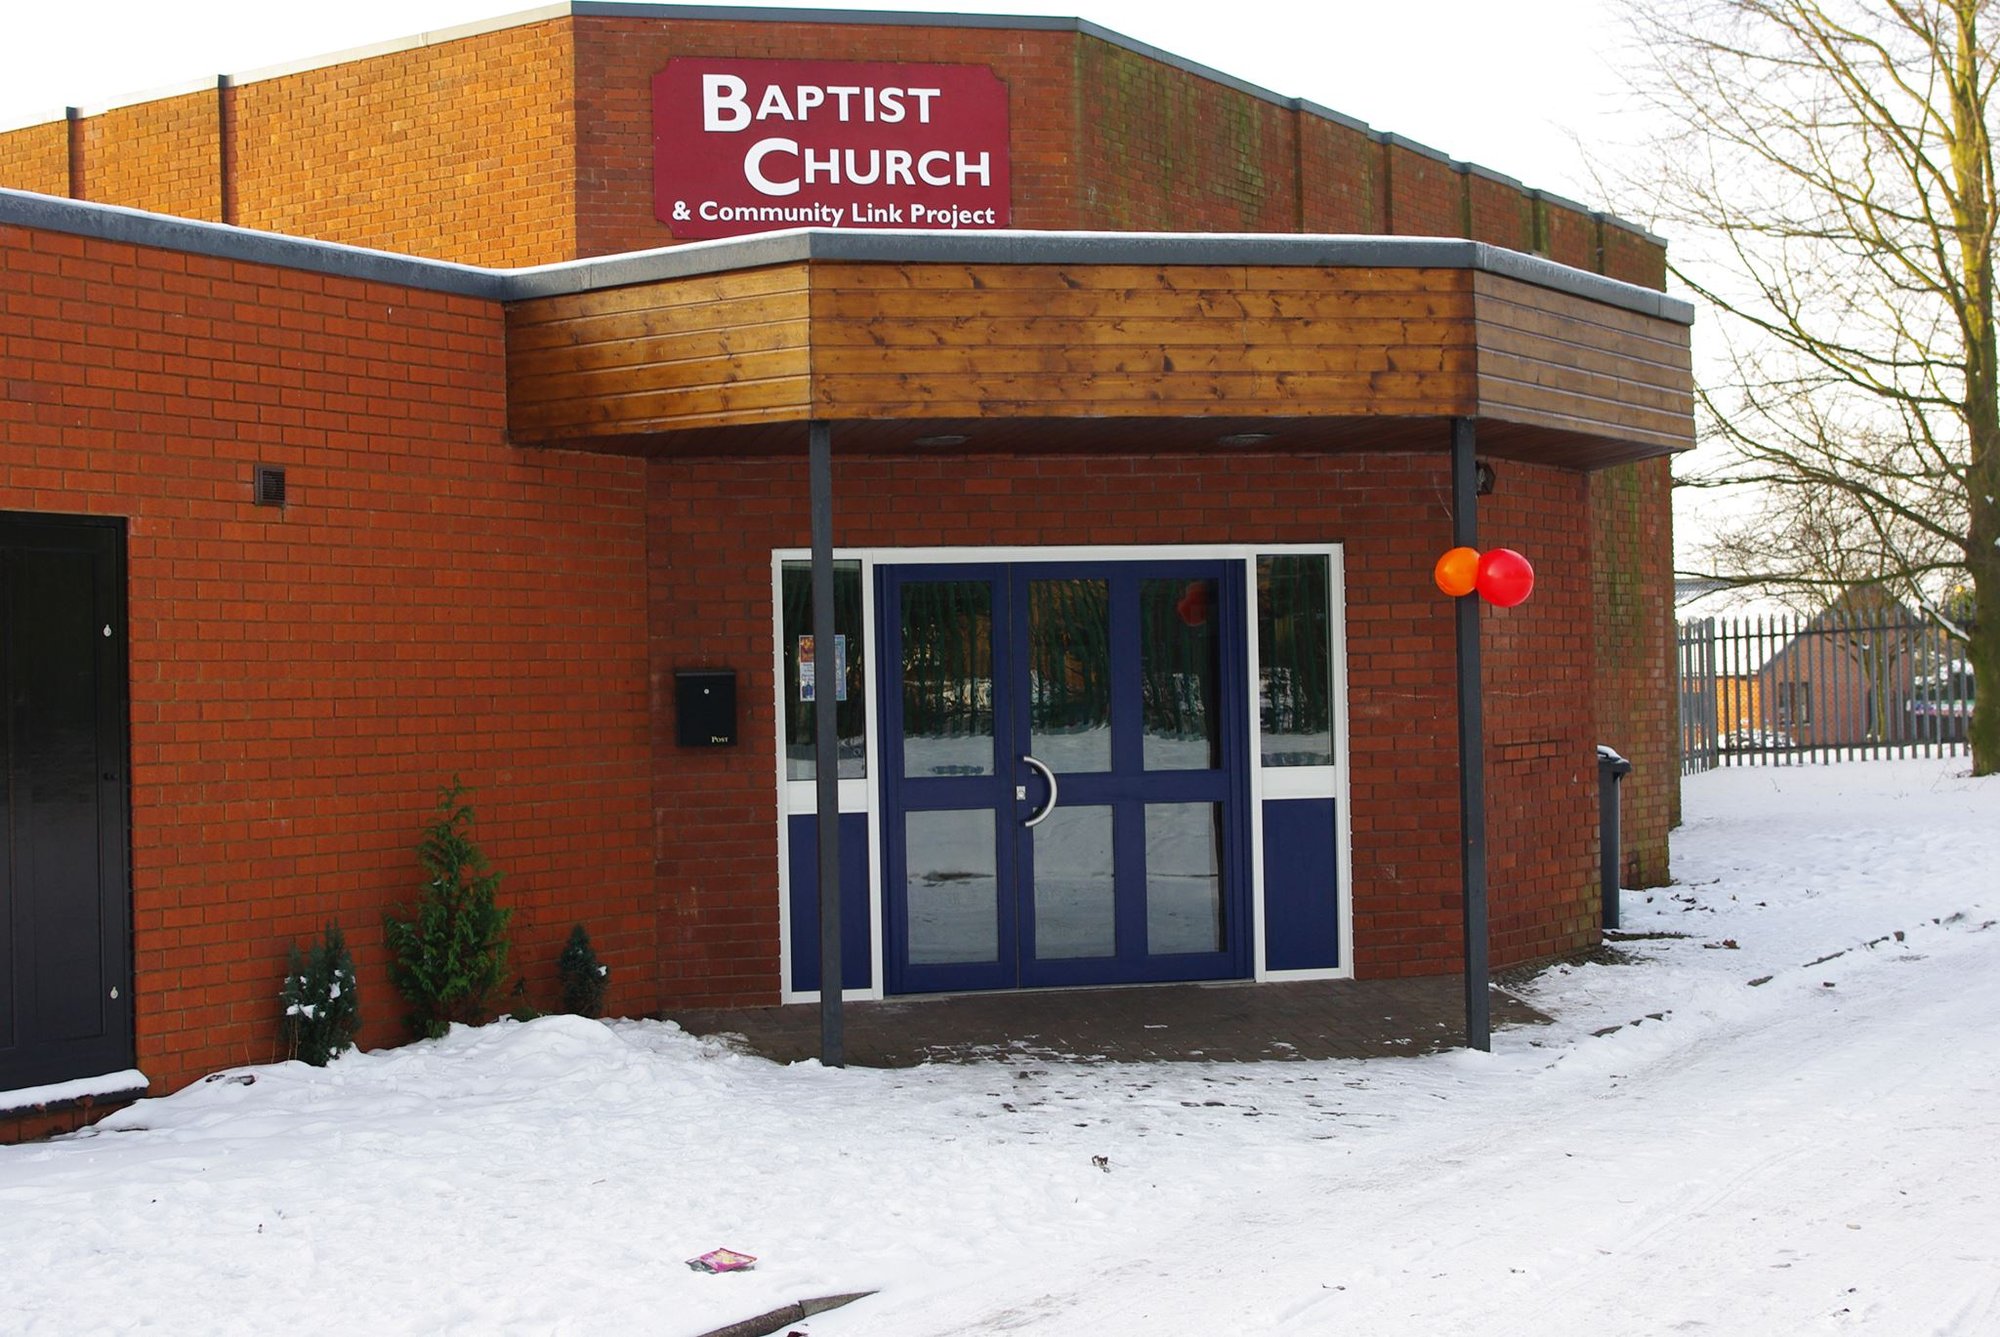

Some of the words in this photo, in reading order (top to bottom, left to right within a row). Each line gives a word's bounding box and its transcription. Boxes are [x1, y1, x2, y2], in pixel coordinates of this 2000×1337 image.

[702, 73, 941, 132] BAPTIST
[743, 137, 991, 196] CHURCH
[672, 200, 691, 222] &
[699, 200, 845, 228] Community
[852, 203, 904, 224] Link
[910, 204, 996, 229] Project
